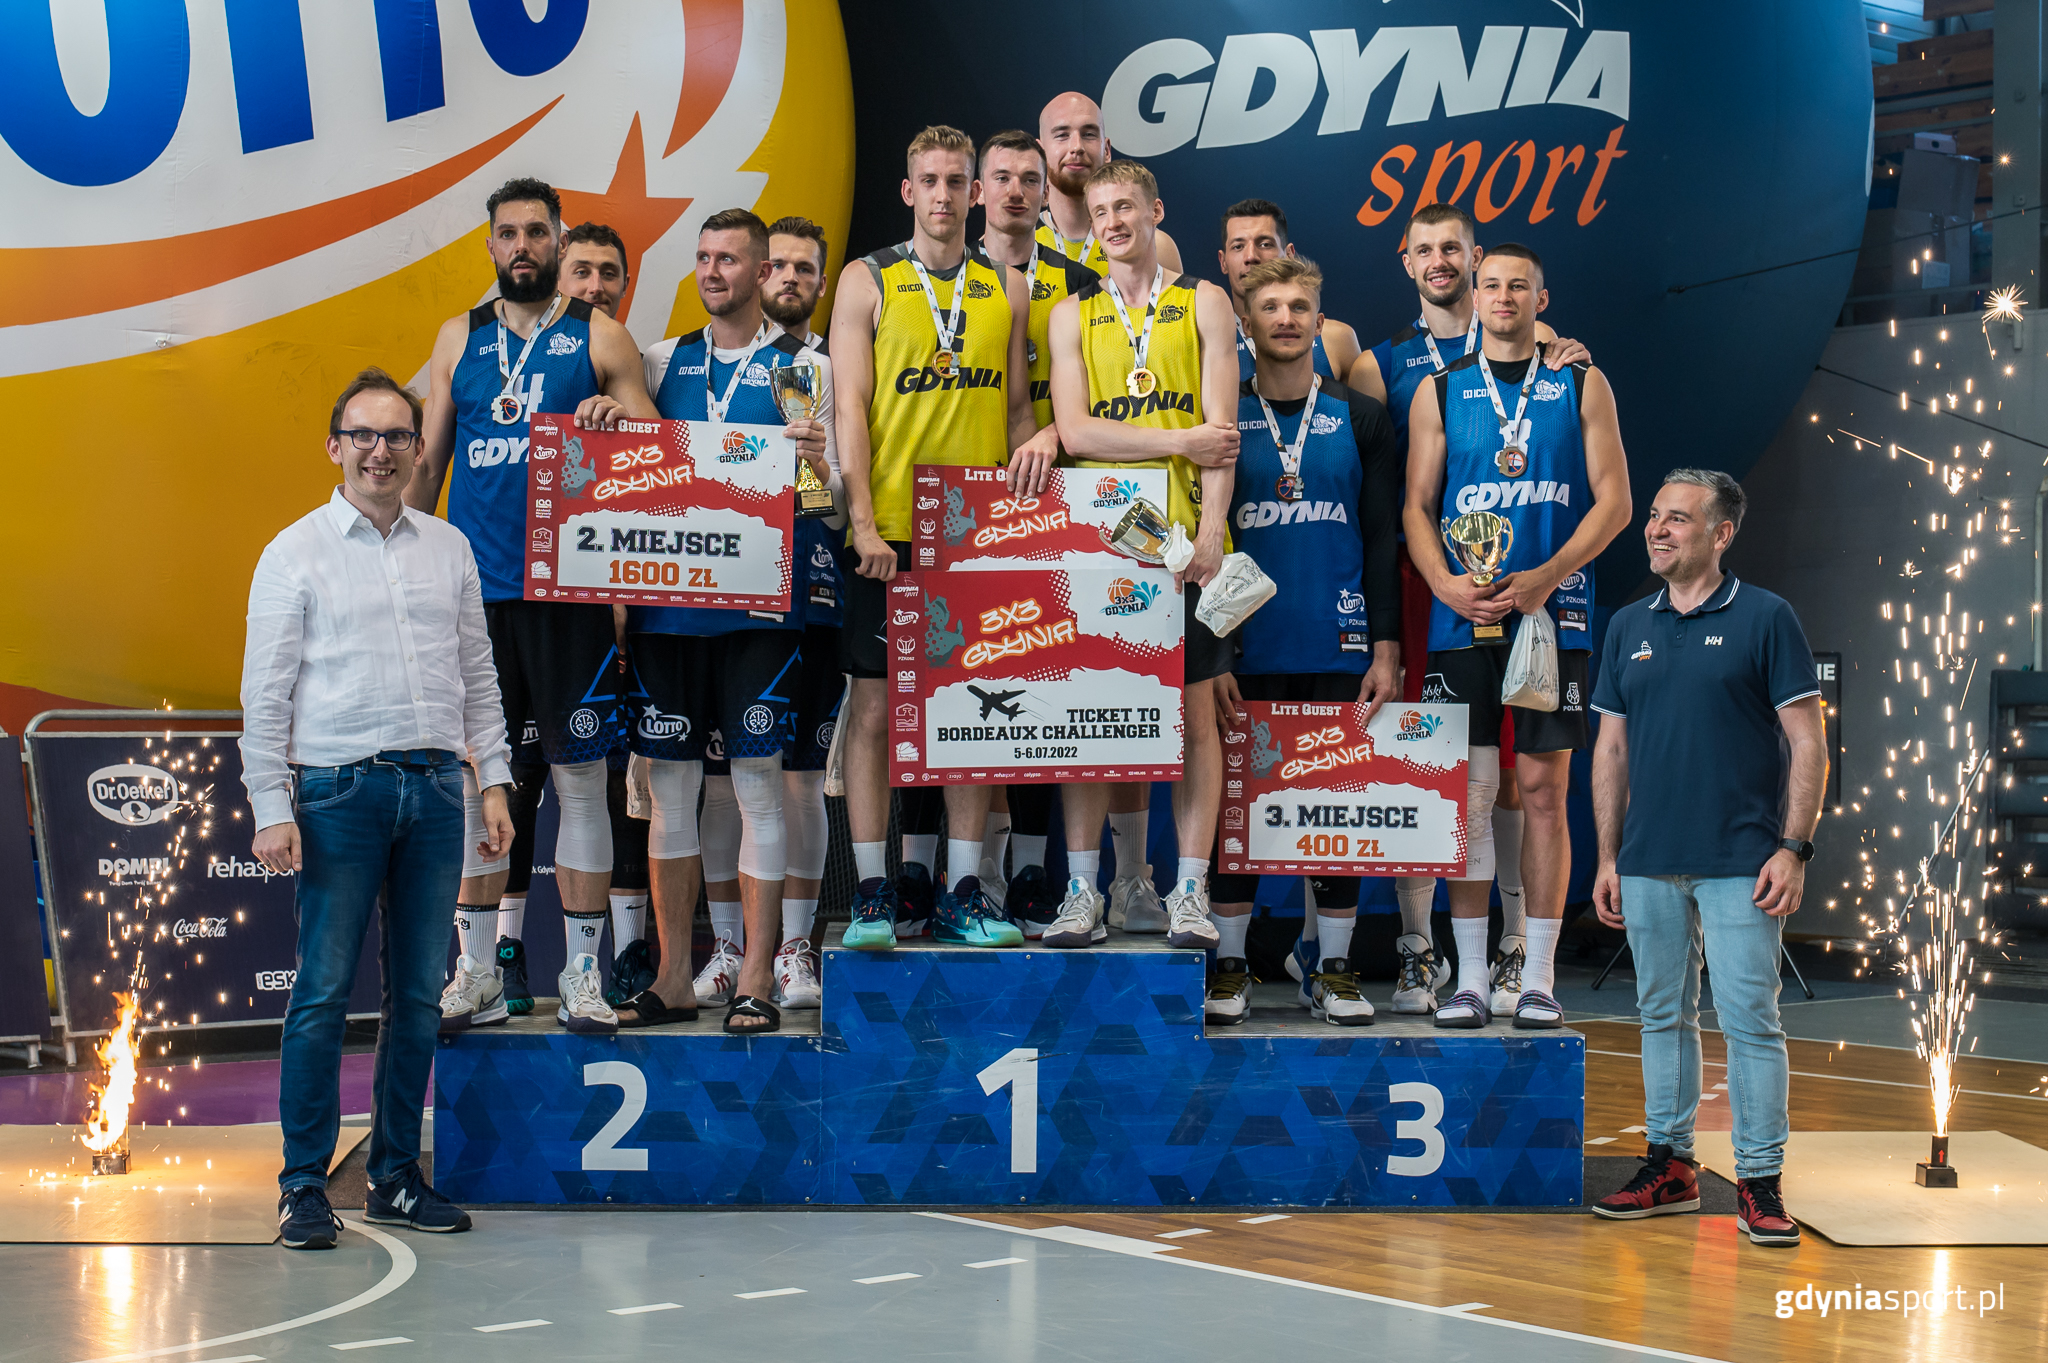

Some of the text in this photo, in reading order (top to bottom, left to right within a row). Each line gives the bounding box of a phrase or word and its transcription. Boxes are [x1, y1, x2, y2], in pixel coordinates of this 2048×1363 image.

[1101, 26, 1630, 157] GDYNIA
[1356, 124, 1628, 252] sport
[1097, 315, 1115, 326] ICON
[687, 365, 706, 375] ICON
[895, 366, 1002, 396] GDYNIA
[1092, 390, 1194, 422] GDYNIA
[618, 419, 661, 434] QUEST
[1249, 420, 1268, 430] ICON
[468, 437, 530, 468] GDY
[610, 443, 665, 472] 3X3
[719, 452, 757, 464] GDYNIA
[727, 445, 747, 454] 3x3
[592, 463, 694, 501] GDYNIA
[964, 468, 993, 481] LITE
[1093, 497, 1130, 509] GDYNIA
[1101, 490, 1119, 499] 3x3
[1455, 481, 1570, 514] GDYNIA
[1236, 500, 1347, 529] GDYNIA
[974, 510, 1068, 548] GDYNIA
[576, 525, 742, 559] 2. MIEJSCE
[608, 559, 718, 588] 1600 ZŁ
[892, 586, 919, 594] GDYNIA
[1114, 594, 1136, 604] 3x3
[1105, 598, 1148, 616] GDYNIA
[1343, 597, 1362, 610] LOTTO
[898, 614, 915, 623] LOTTO
[980, 598, 1042, 633] 3X3
[1566, 611, 1579, 620] ICON
[962, 619, 1077, 669] GDYNIA
[1348, 633, 1361, 642] ICON
[1704, 636, 1723, 646] HH
[1066, 707, 1161, 723] TICKET TO
[1271, 703, 1342, 717] LITE QUEST
[646, 718, 683, 734] LOTTO
[937, 723, 1161, 742] BORDEAUX CHALLENGER
[1296, 725, 1346, 754] 3X3
[1396, 730, 1432, 742] GDYNIA
[1014, 746, 1078, 759] 5-6.07.2022
[1279, 743, 1372, 780] GDYNIA
[1264, 804, 1419, 829] 3. MIEJSCE
[1296, 834, 1385, 858] 400 ZŁ
[581, 1060, 649, 1172] 2
[975, 1048, 1039, 1174] 1
[1387, 1082, 1446, 1177] 3
